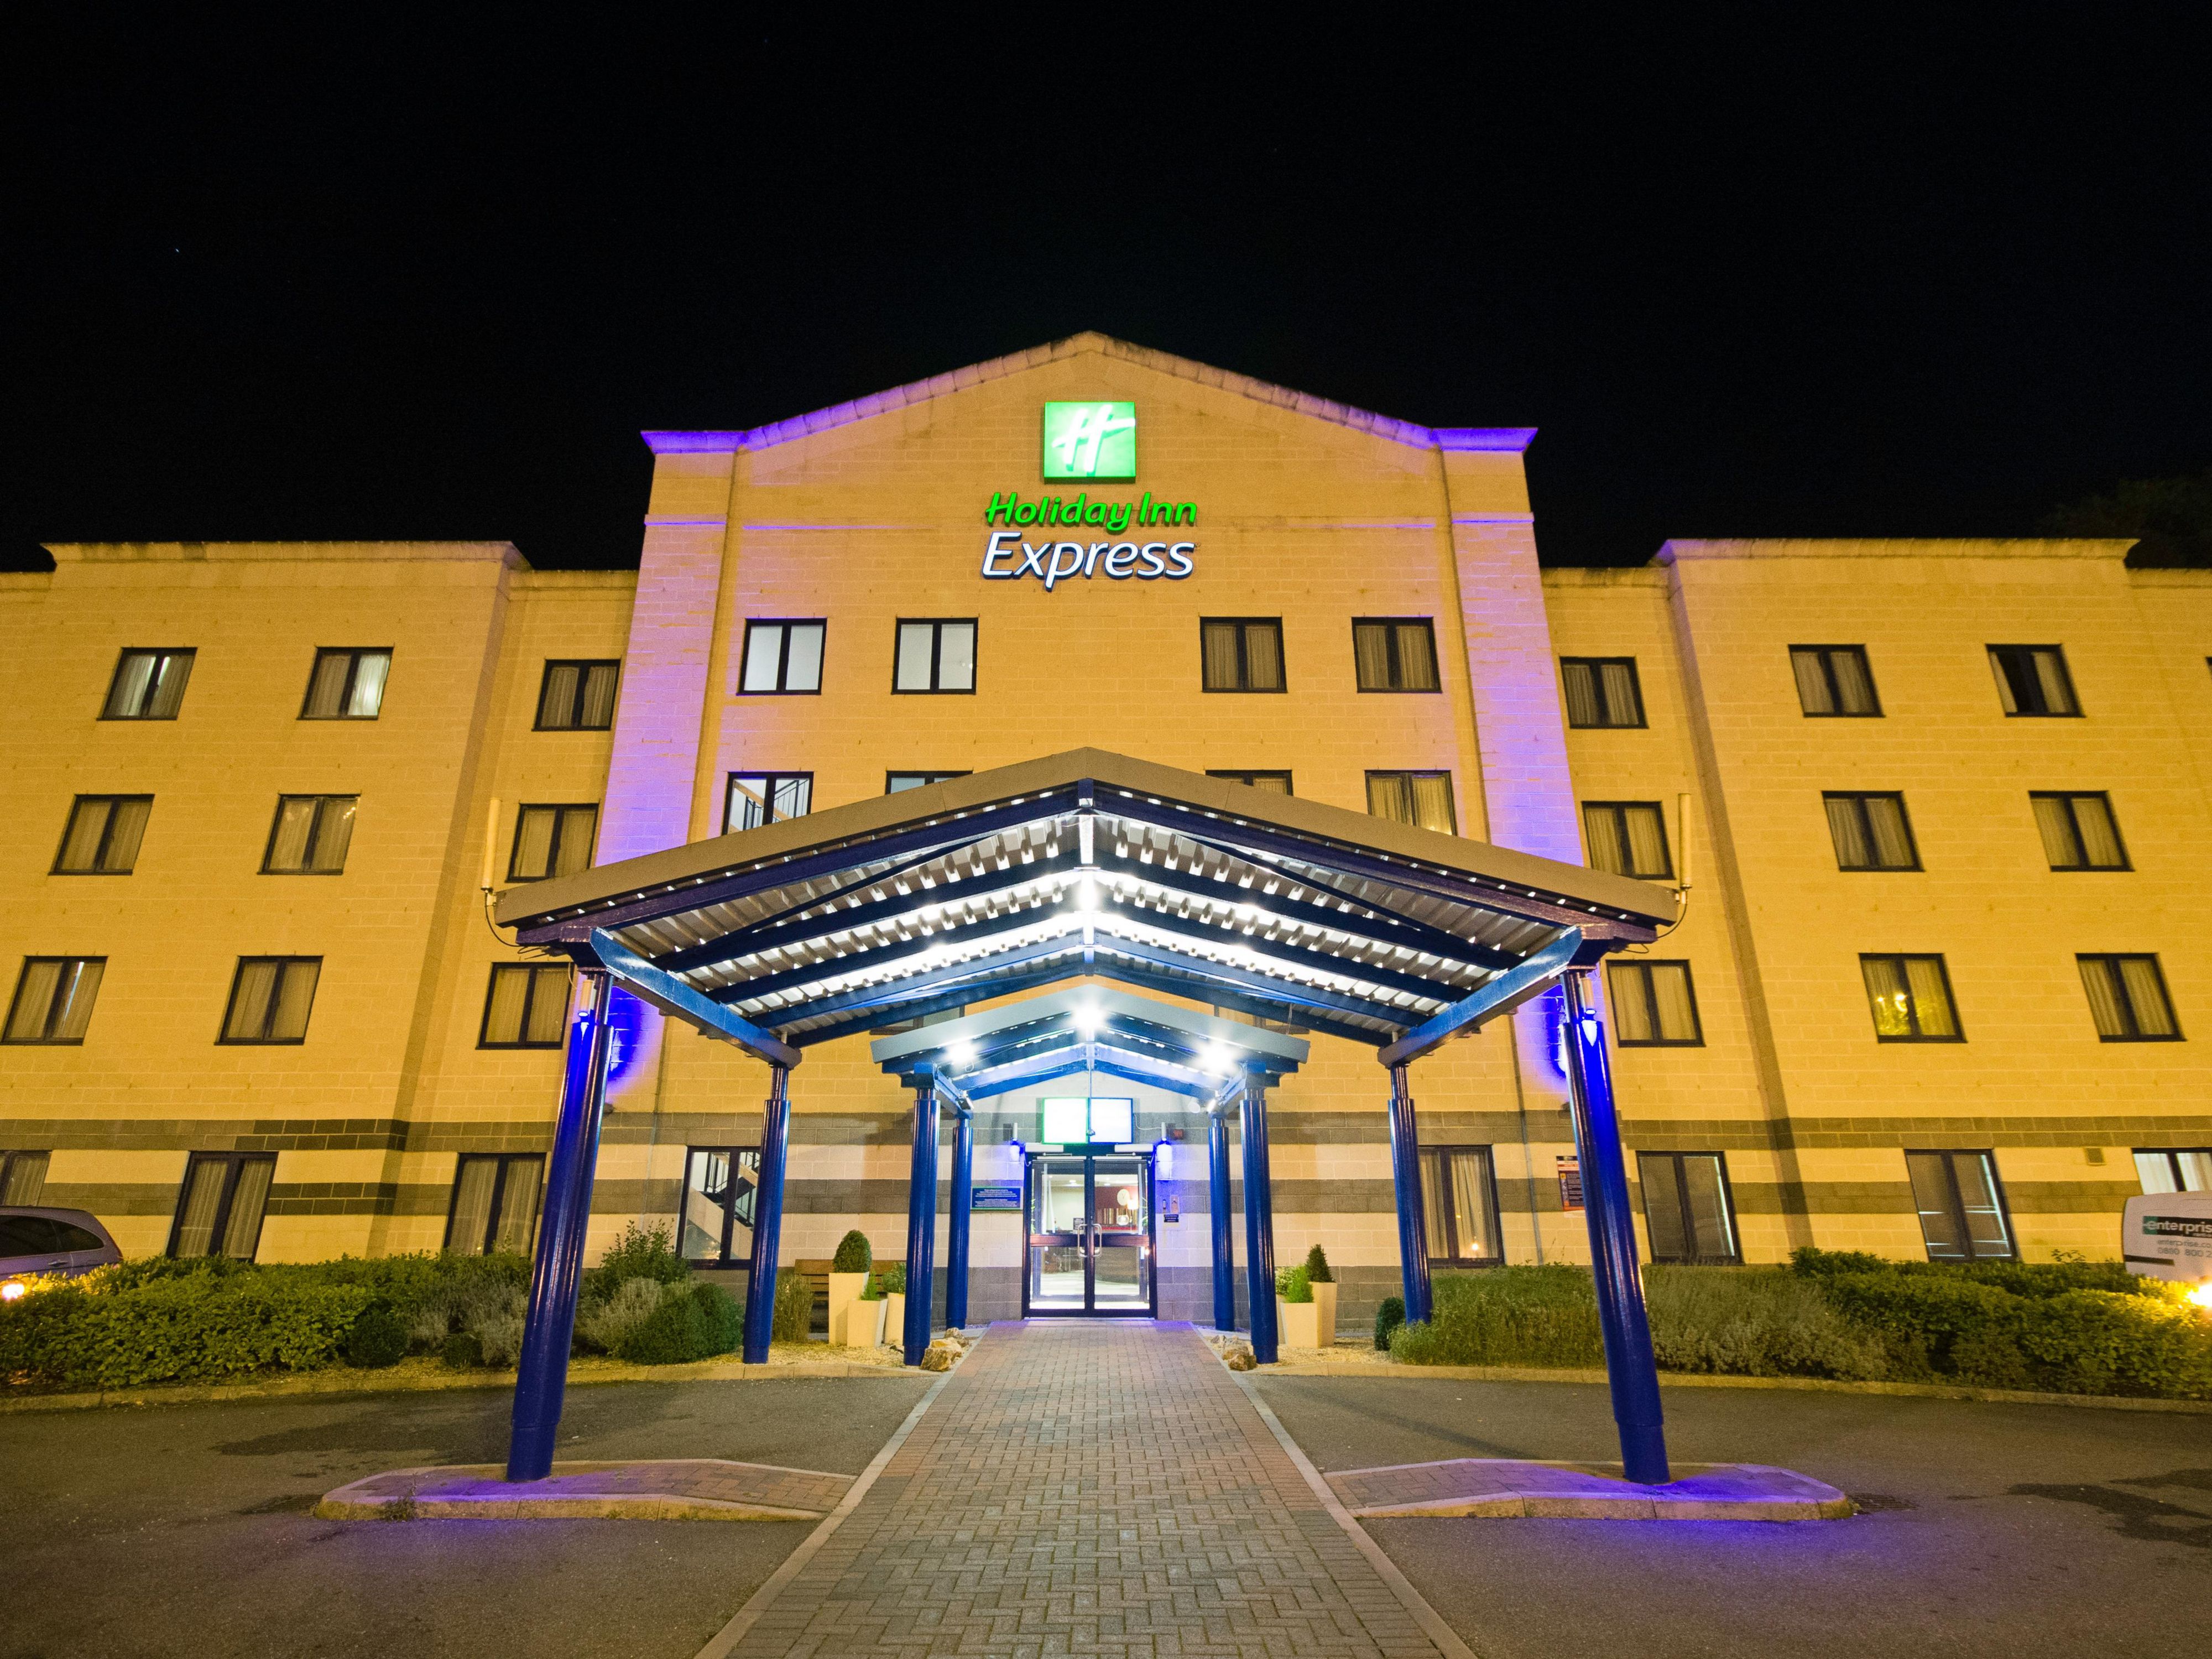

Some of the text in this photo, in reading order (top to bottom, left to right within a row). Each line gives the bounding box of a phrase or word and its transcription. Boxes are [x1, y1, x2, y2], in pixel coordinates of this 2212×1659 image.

[985, 492, 1198, 531] Holiday Inn
[982, 531, 1195, 590] Express
